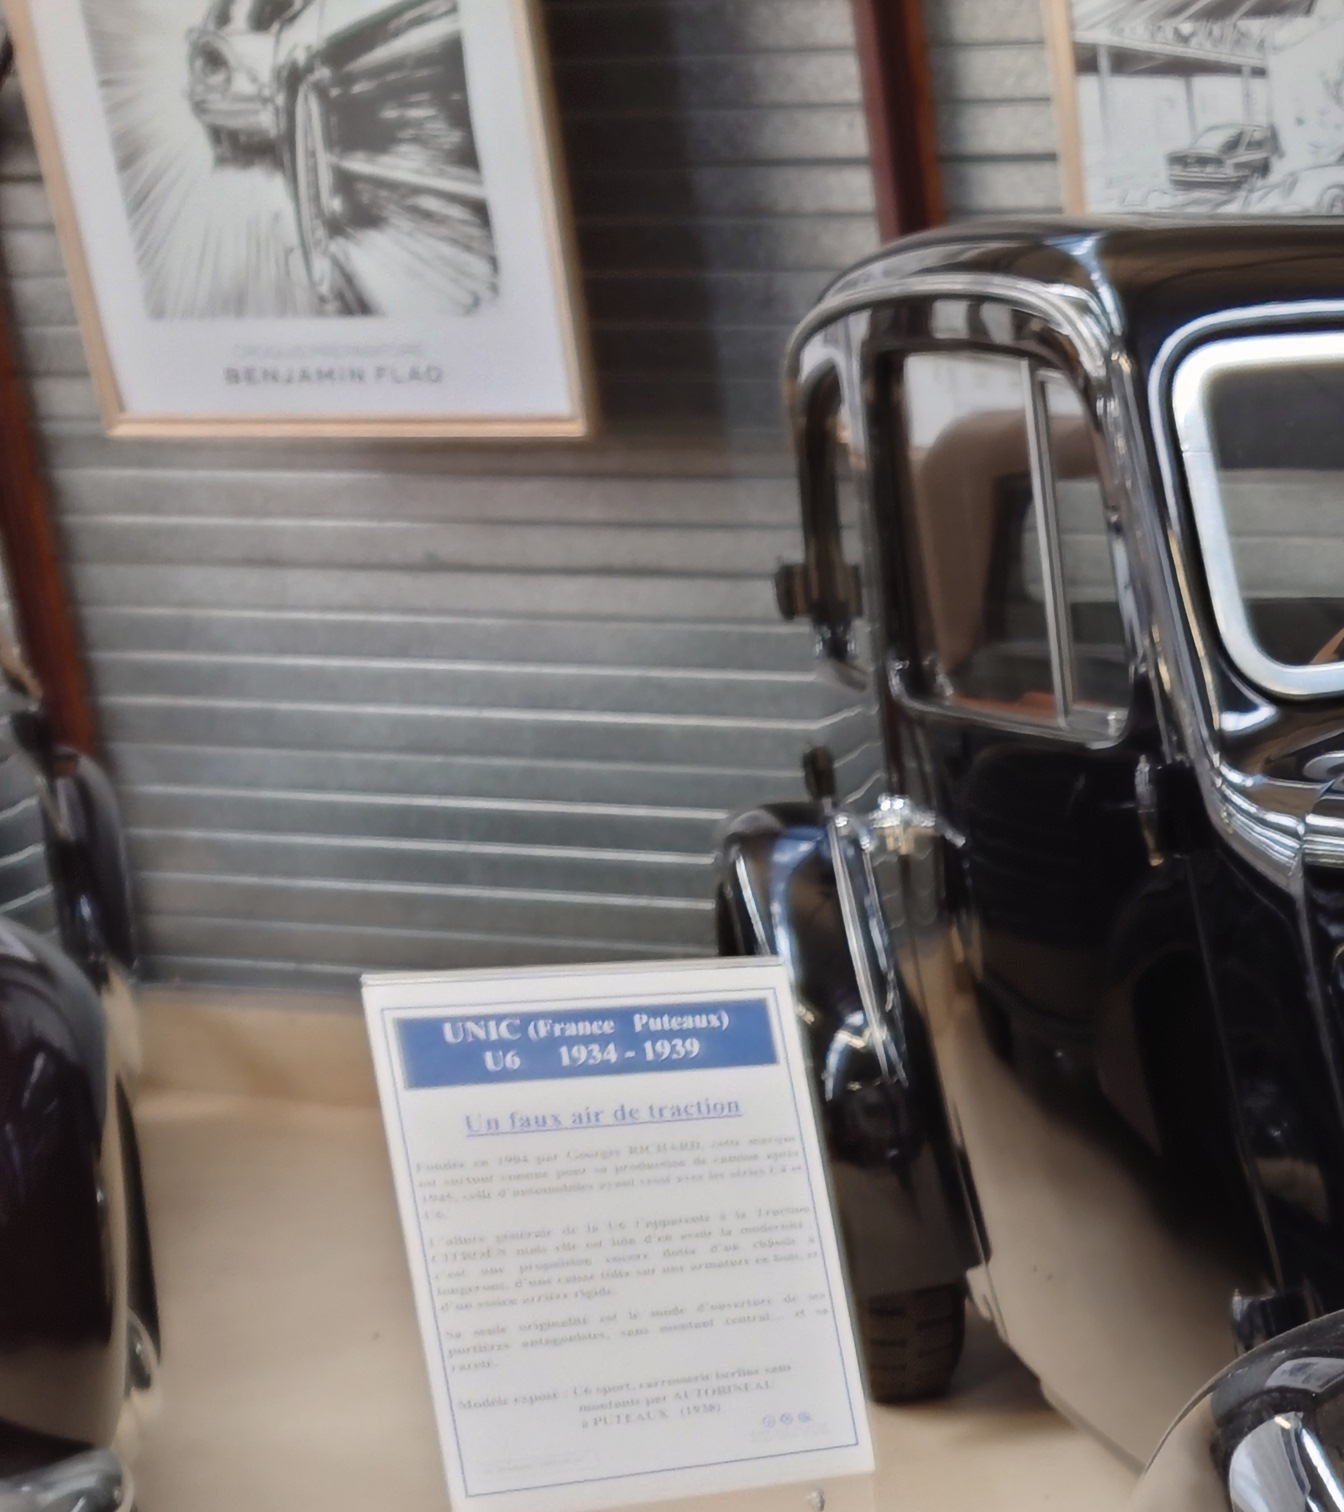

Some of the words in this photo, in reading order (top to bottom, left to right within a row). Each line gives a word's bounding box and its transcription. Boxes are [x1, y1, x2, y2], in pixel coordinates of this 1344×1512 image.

[223, 366, 366, 384] BENJAMIN
[441, 1018, 523, 1045] UNIC
[527, 1014, 616, 1041] (France
[632, 1009, 730, 1035] Puteaux)
[483, 1049, 522, 1073] U6
[558, 1042, 619, 1068] 1934
[643, 1037, 701, 1062] 1939
[464, 1113, 502, 1134] Un
[507, 1109, 562, 1130] faux
[570, 1104, 604, 1126] air
[613, 1102, 640, 1123] de
[648, 1096, 743, 1119] traction
